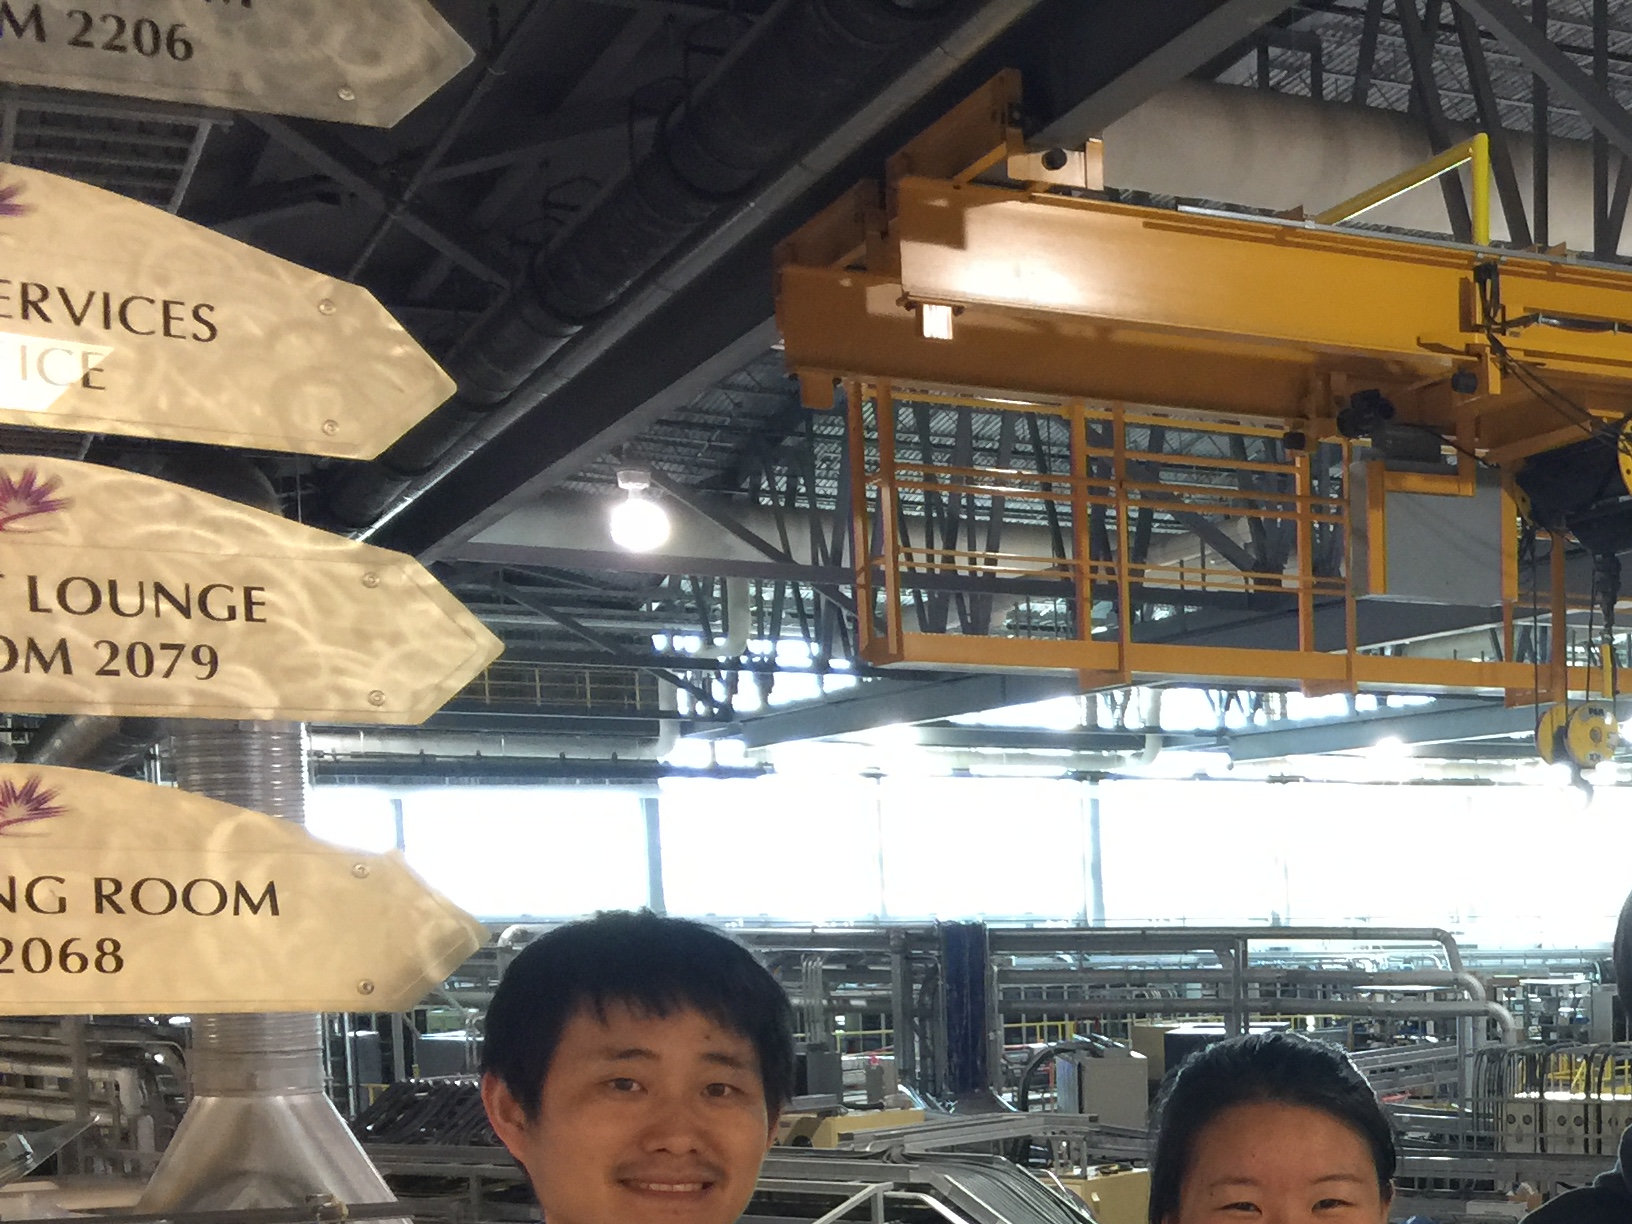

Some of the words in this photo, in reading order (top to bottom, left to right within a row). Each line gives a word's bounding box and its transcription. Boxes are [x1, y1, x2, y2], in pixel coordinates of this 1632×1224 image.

[66, 9, 193, 61] 2206
[27, 575, 267, 624] LOUNGE
[93, 639, 219, 681] 2079
[94, 876, 280, 917] ROOM
